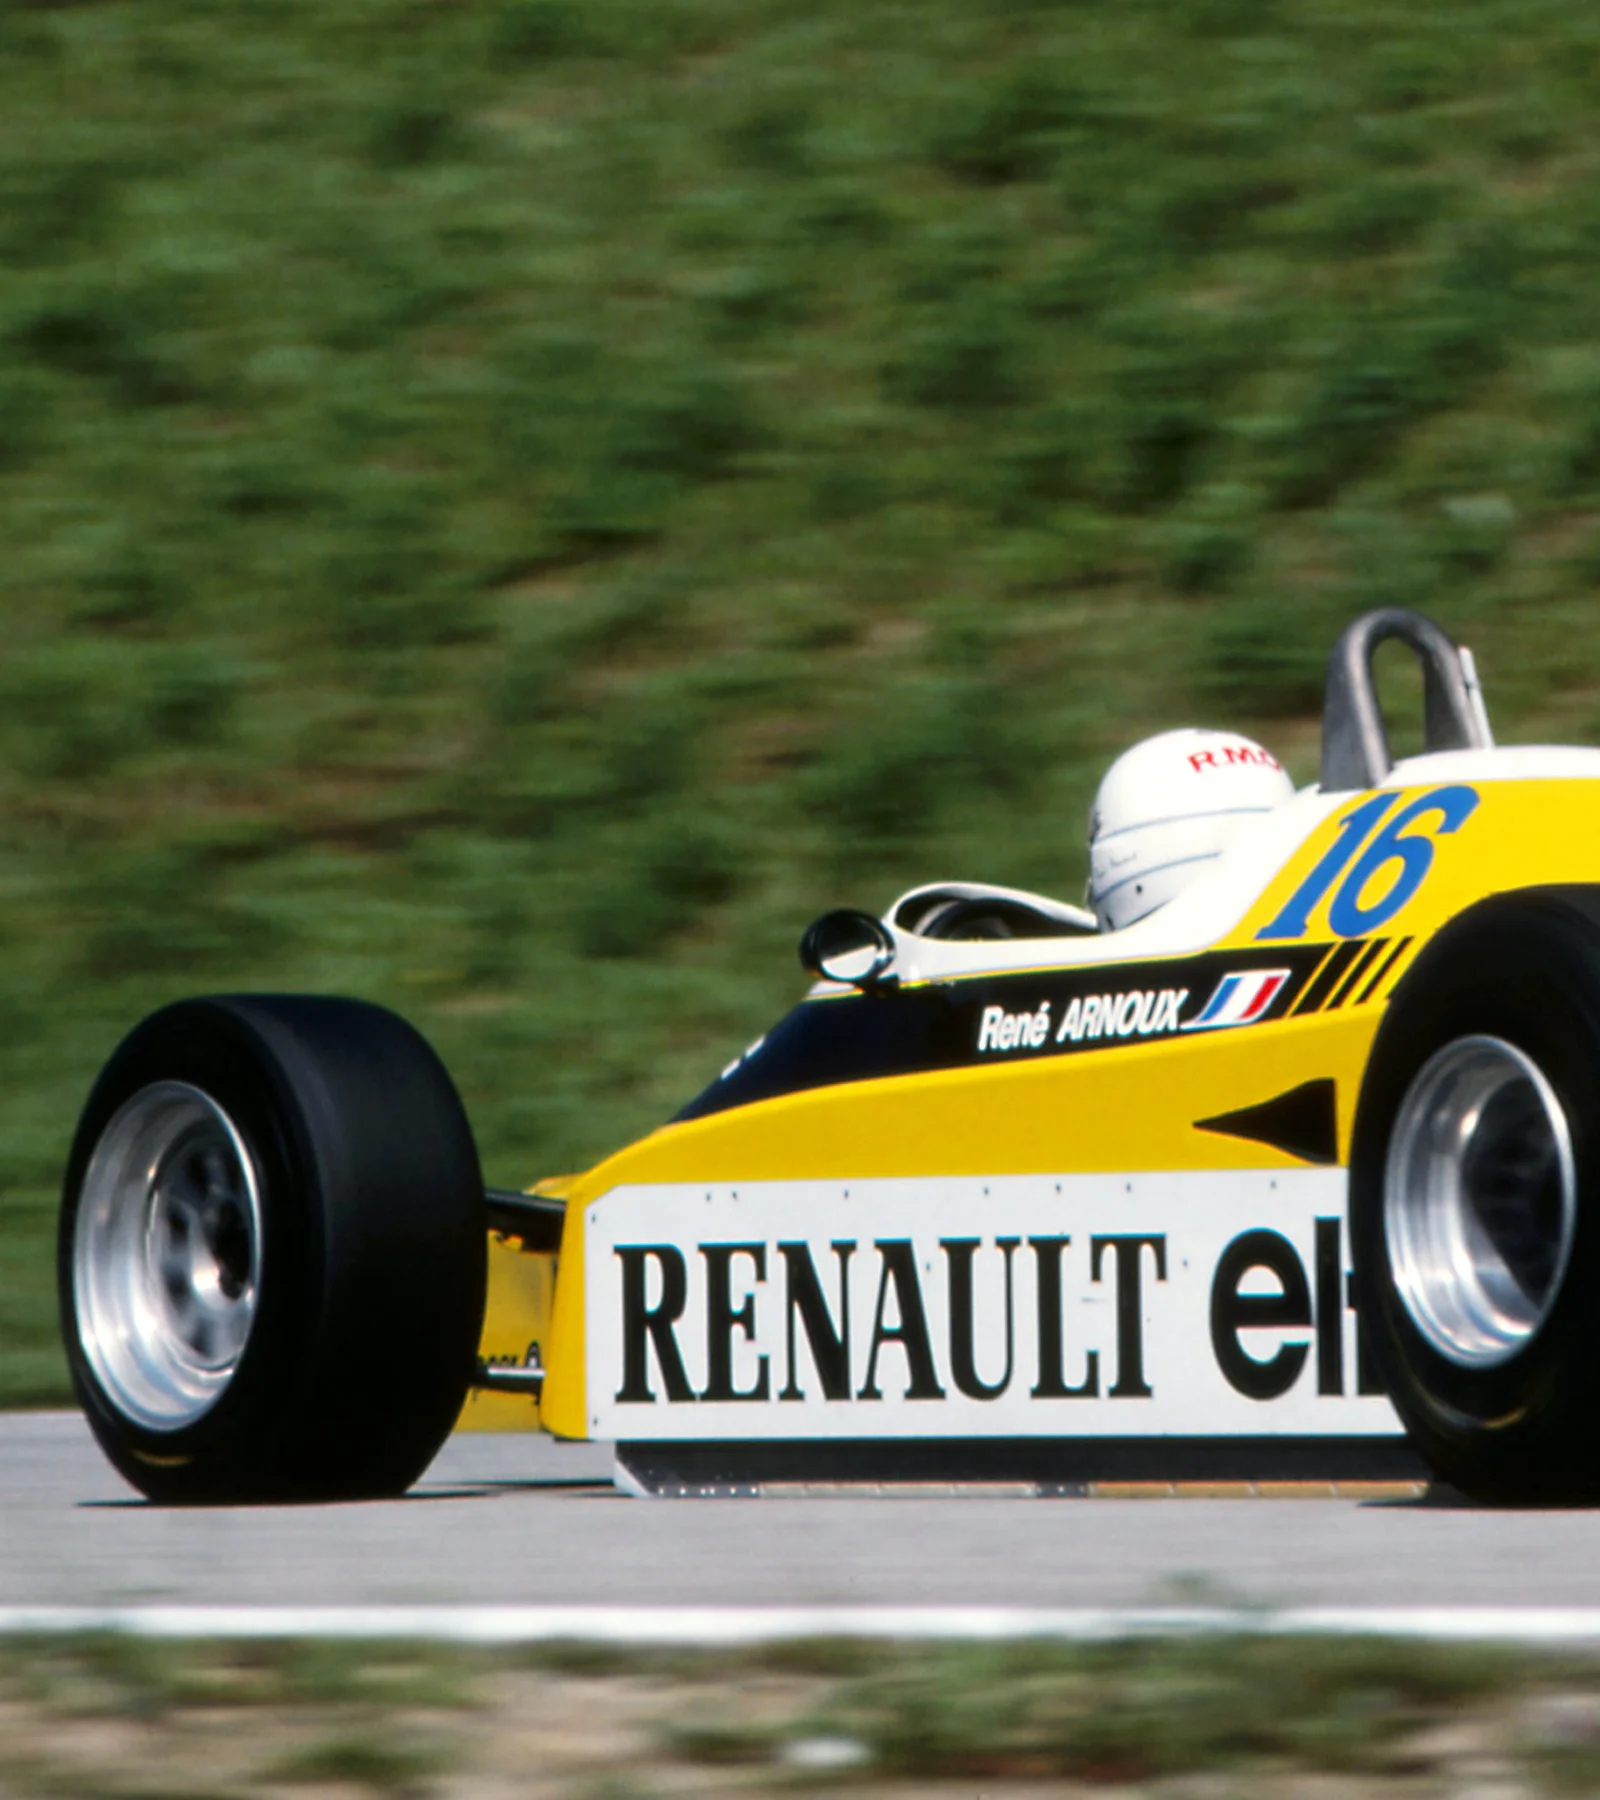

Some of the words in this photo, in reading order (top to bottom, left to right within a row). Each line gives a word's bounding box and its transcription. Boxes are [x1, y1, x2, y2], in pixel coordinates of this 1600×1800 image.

[1254, 785, 1481, 940] 16
[978, 1001, 1051, 1051] René
[1056, 988, 1190, 1042] ARNOUX
[613, 1233, 1168, 1403] RENAULT
